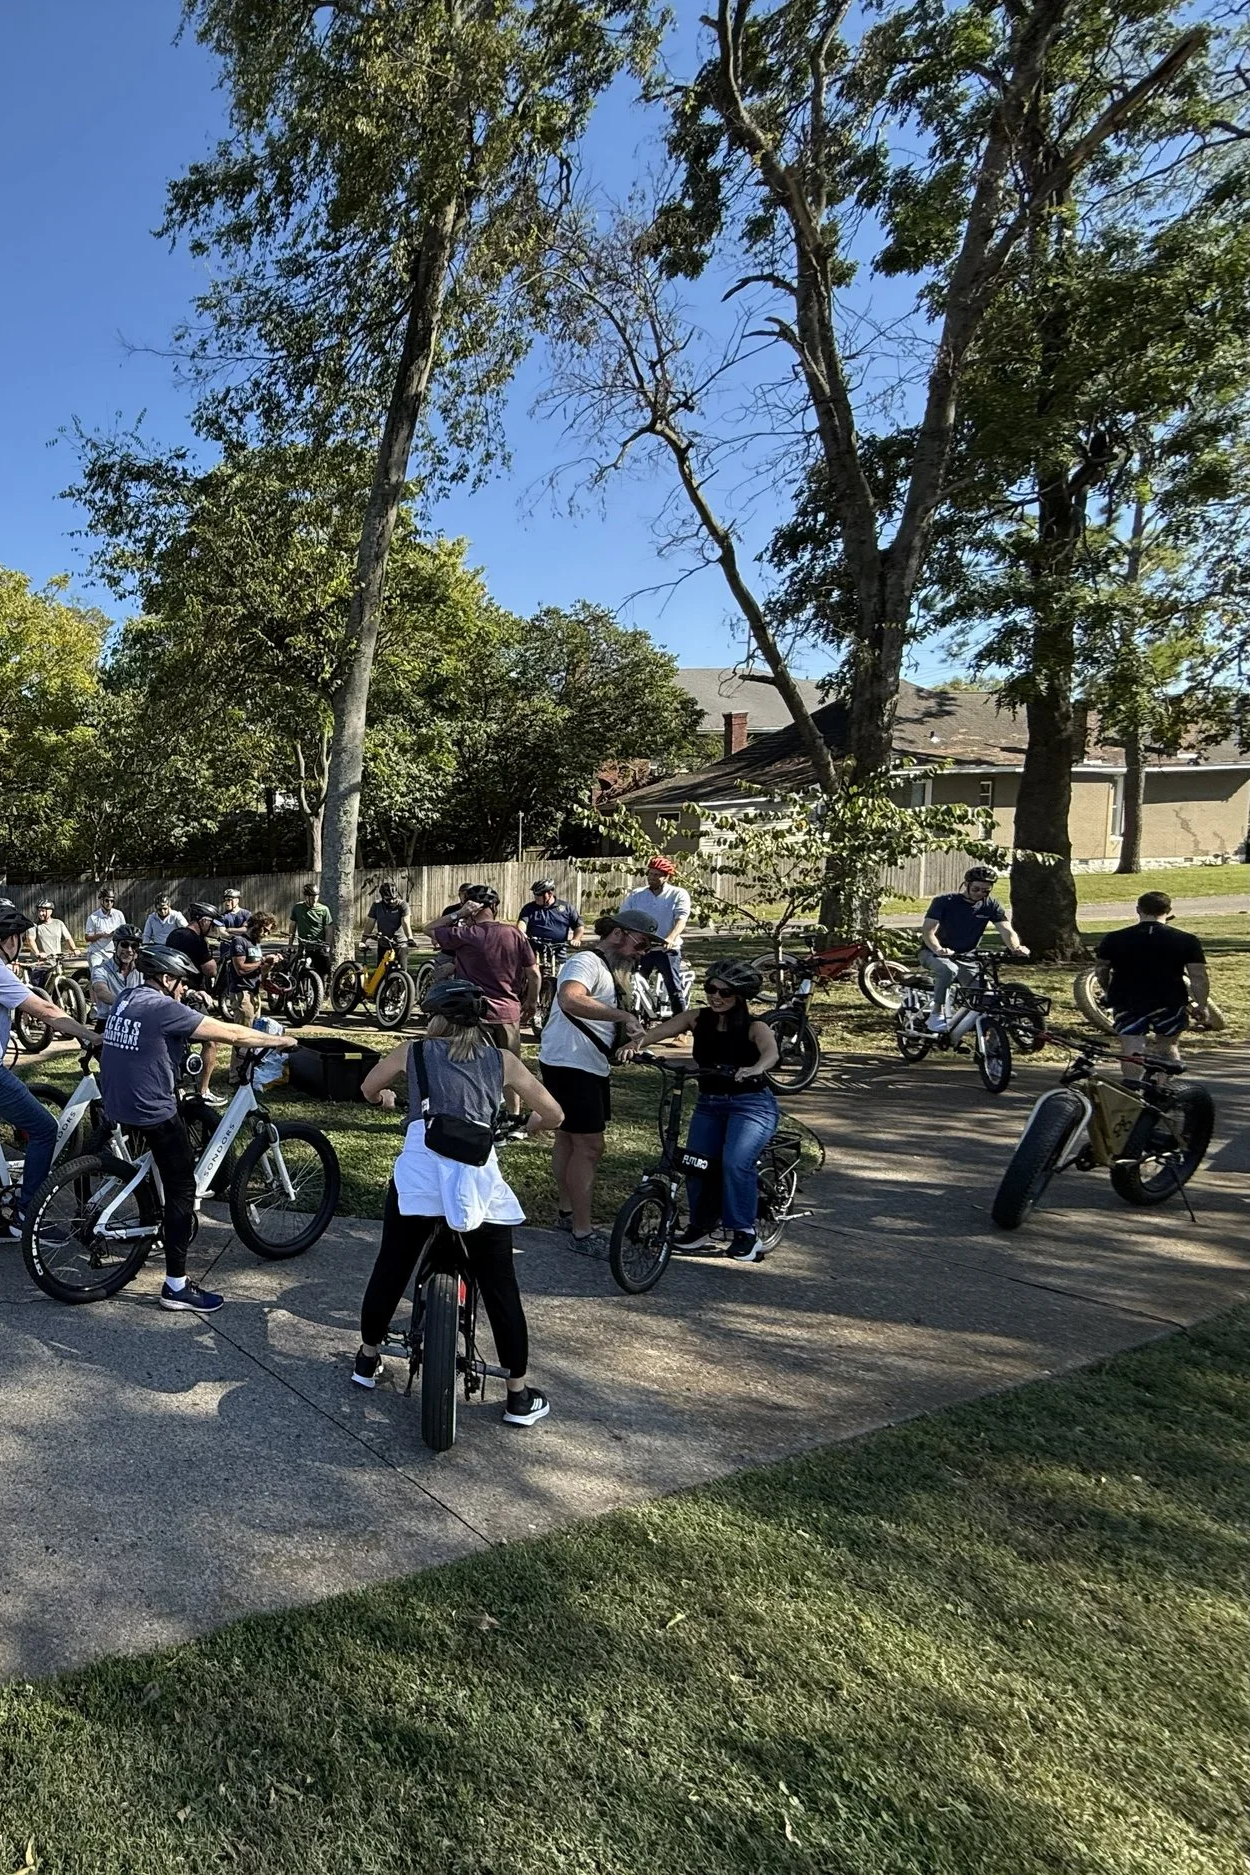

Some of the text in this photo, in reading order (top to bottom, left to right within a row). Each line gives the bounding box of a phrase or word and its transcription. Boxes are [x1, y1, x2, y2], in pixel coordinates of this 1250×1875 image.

[57, 1111, 76, 1142] DORS
[203, 1123, 235, 1177] SONDORS
[33, 1257, 44, 1276] CST
